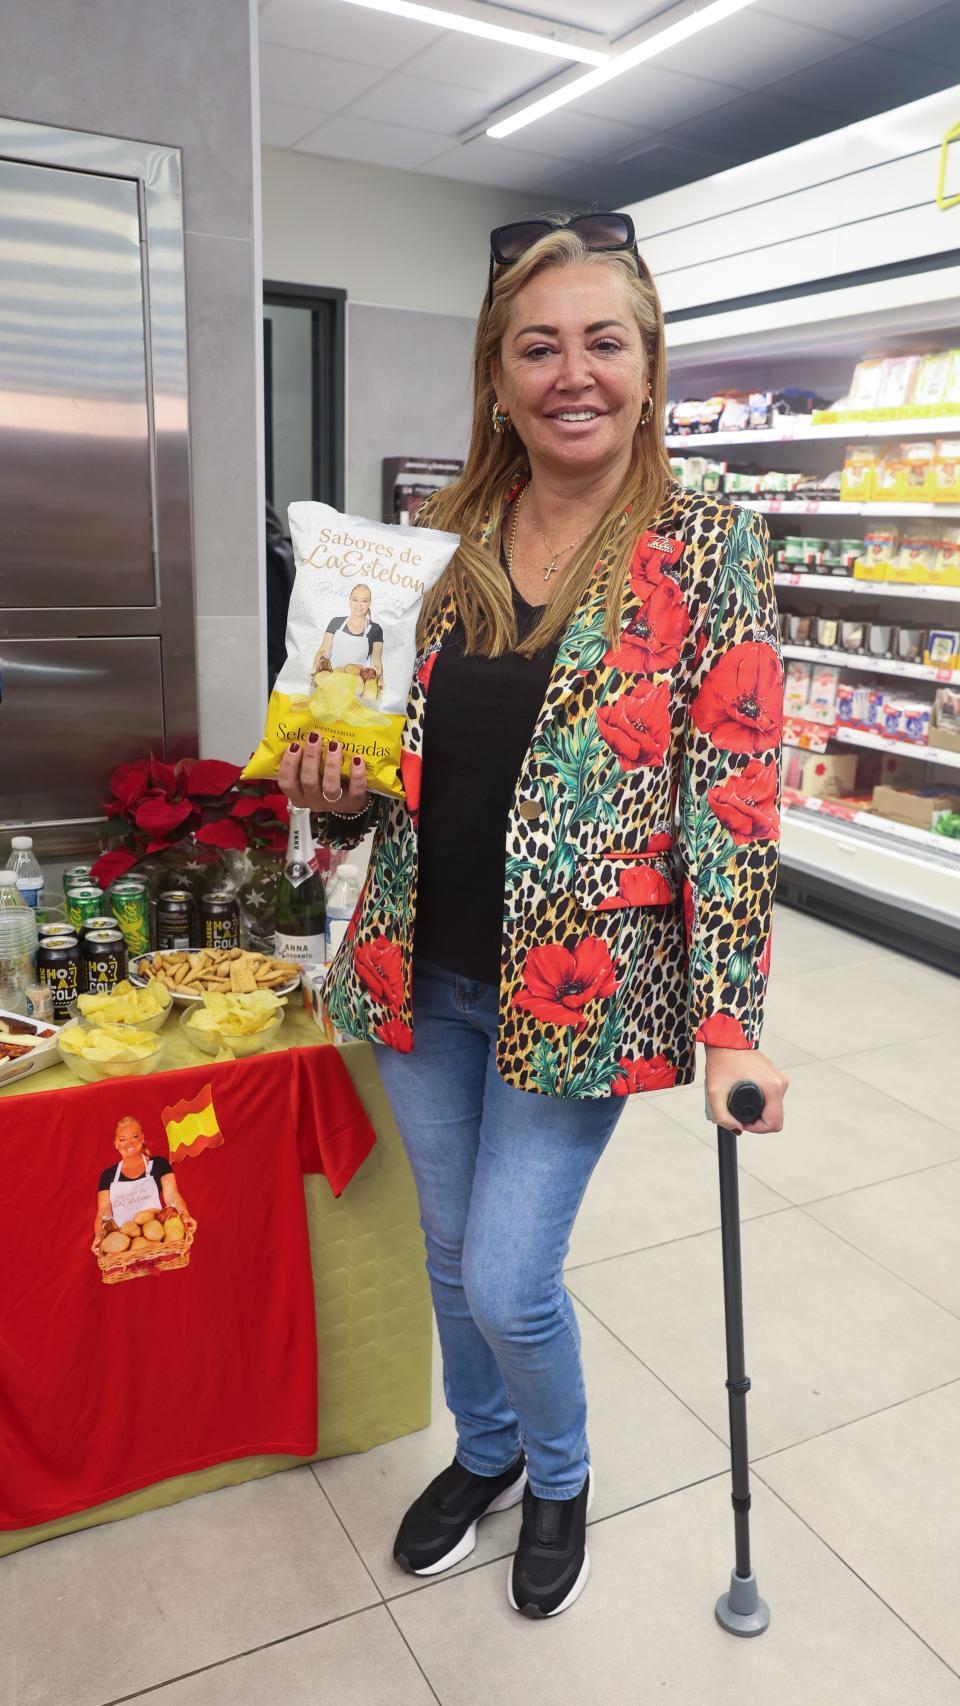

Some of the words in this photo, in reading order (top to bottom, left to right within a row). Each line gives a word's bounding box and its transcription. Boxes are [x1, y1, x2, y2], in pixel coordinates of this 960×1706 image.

[319, 528, 394, 558] Sabores
[400, 547, 422, 566] de
[214, 937, 238, 949] COLA
[284, 943, 309, 952] ANNA
[50, 988, 78, 1001] COLA
